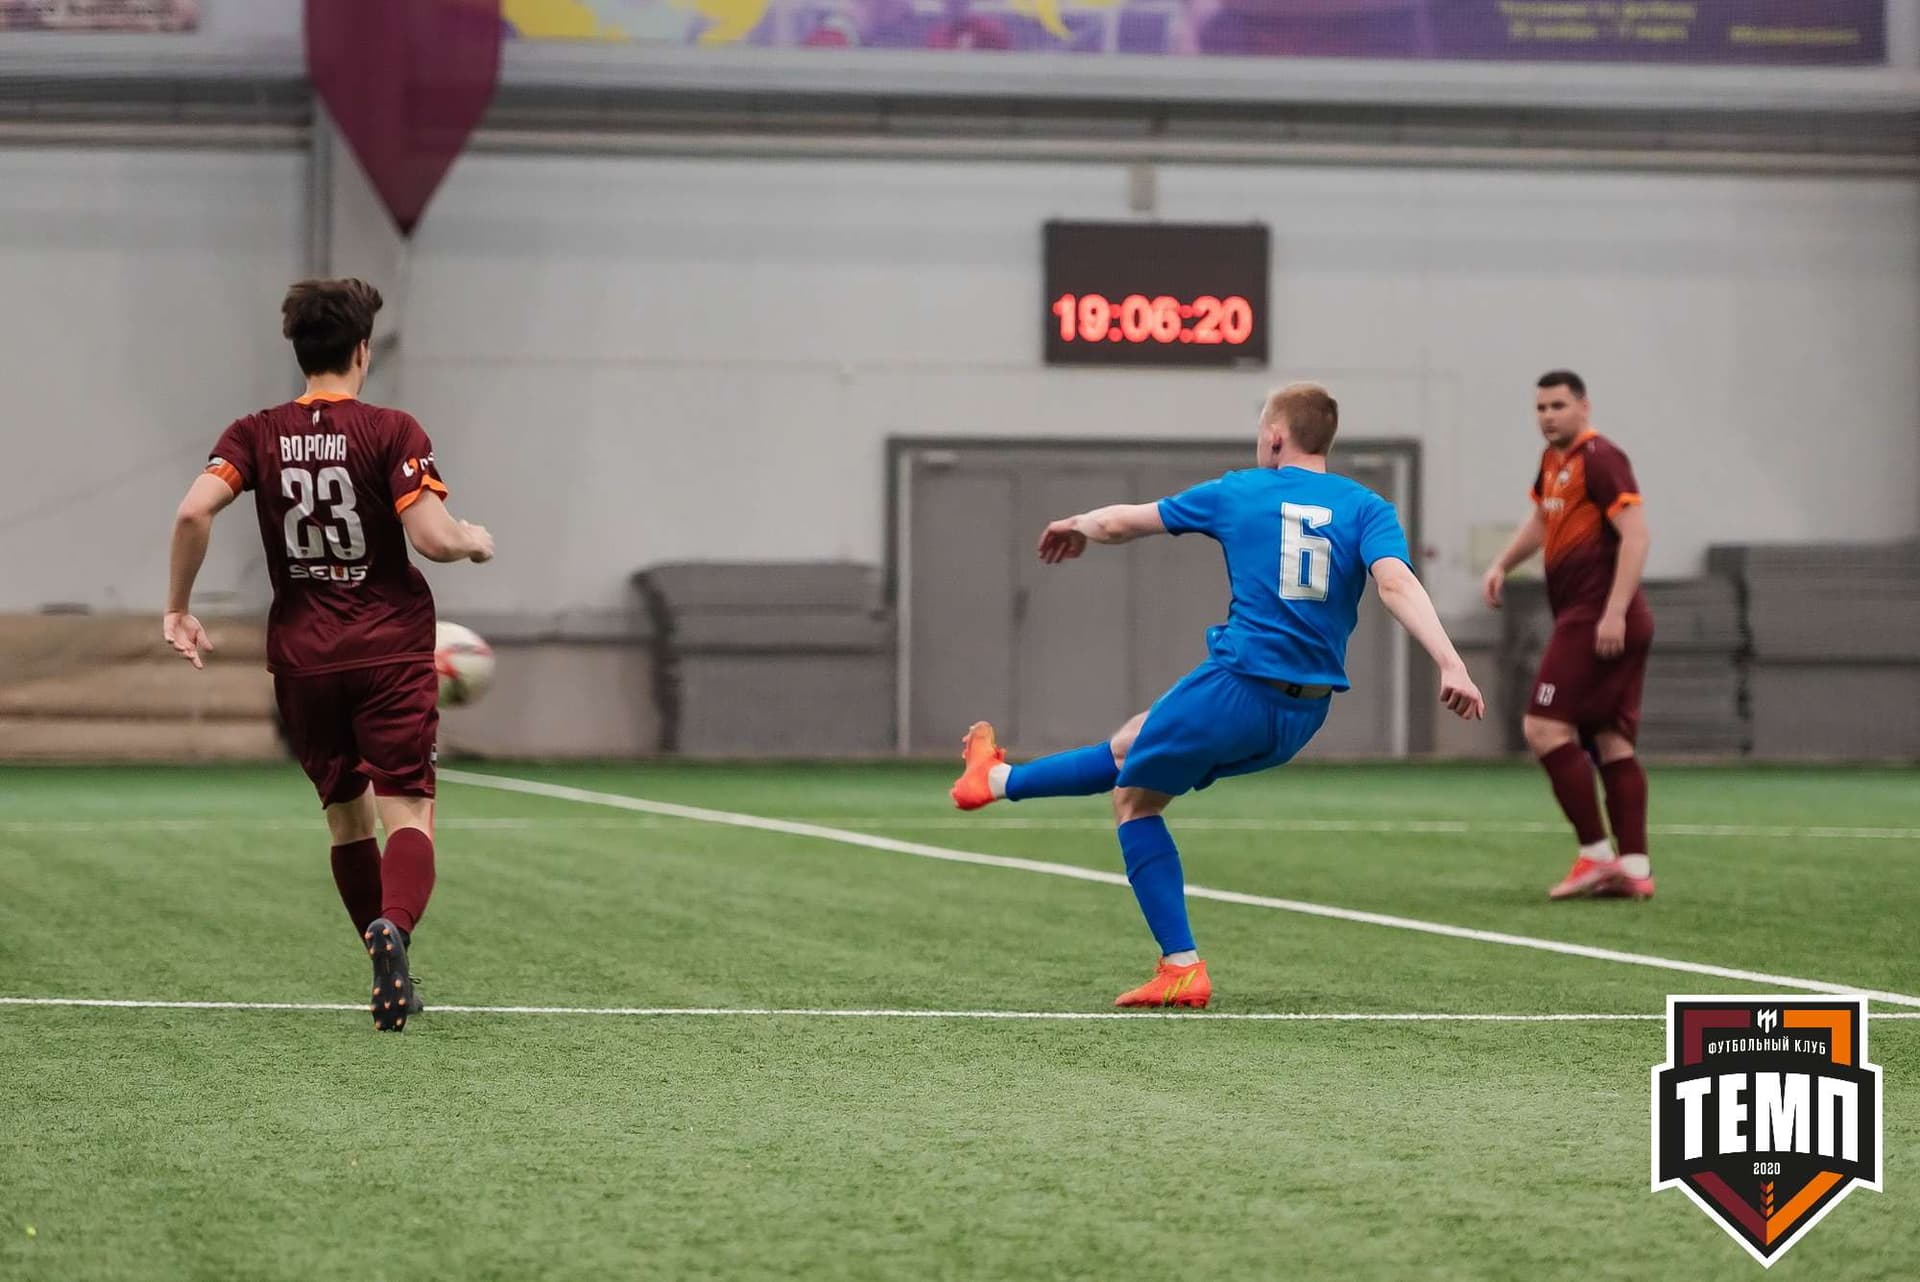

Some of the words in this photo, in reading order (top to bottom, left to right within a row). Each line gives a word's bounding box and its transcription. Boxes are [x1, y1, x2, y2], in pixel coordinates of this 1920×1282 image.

[1052, 293, 1253, 344] 19:06:20
[280, 433, 347, 462] ВОРОНА
[281, 466, 367, 561] 23
[1279, 502, 1333, 601] 6
